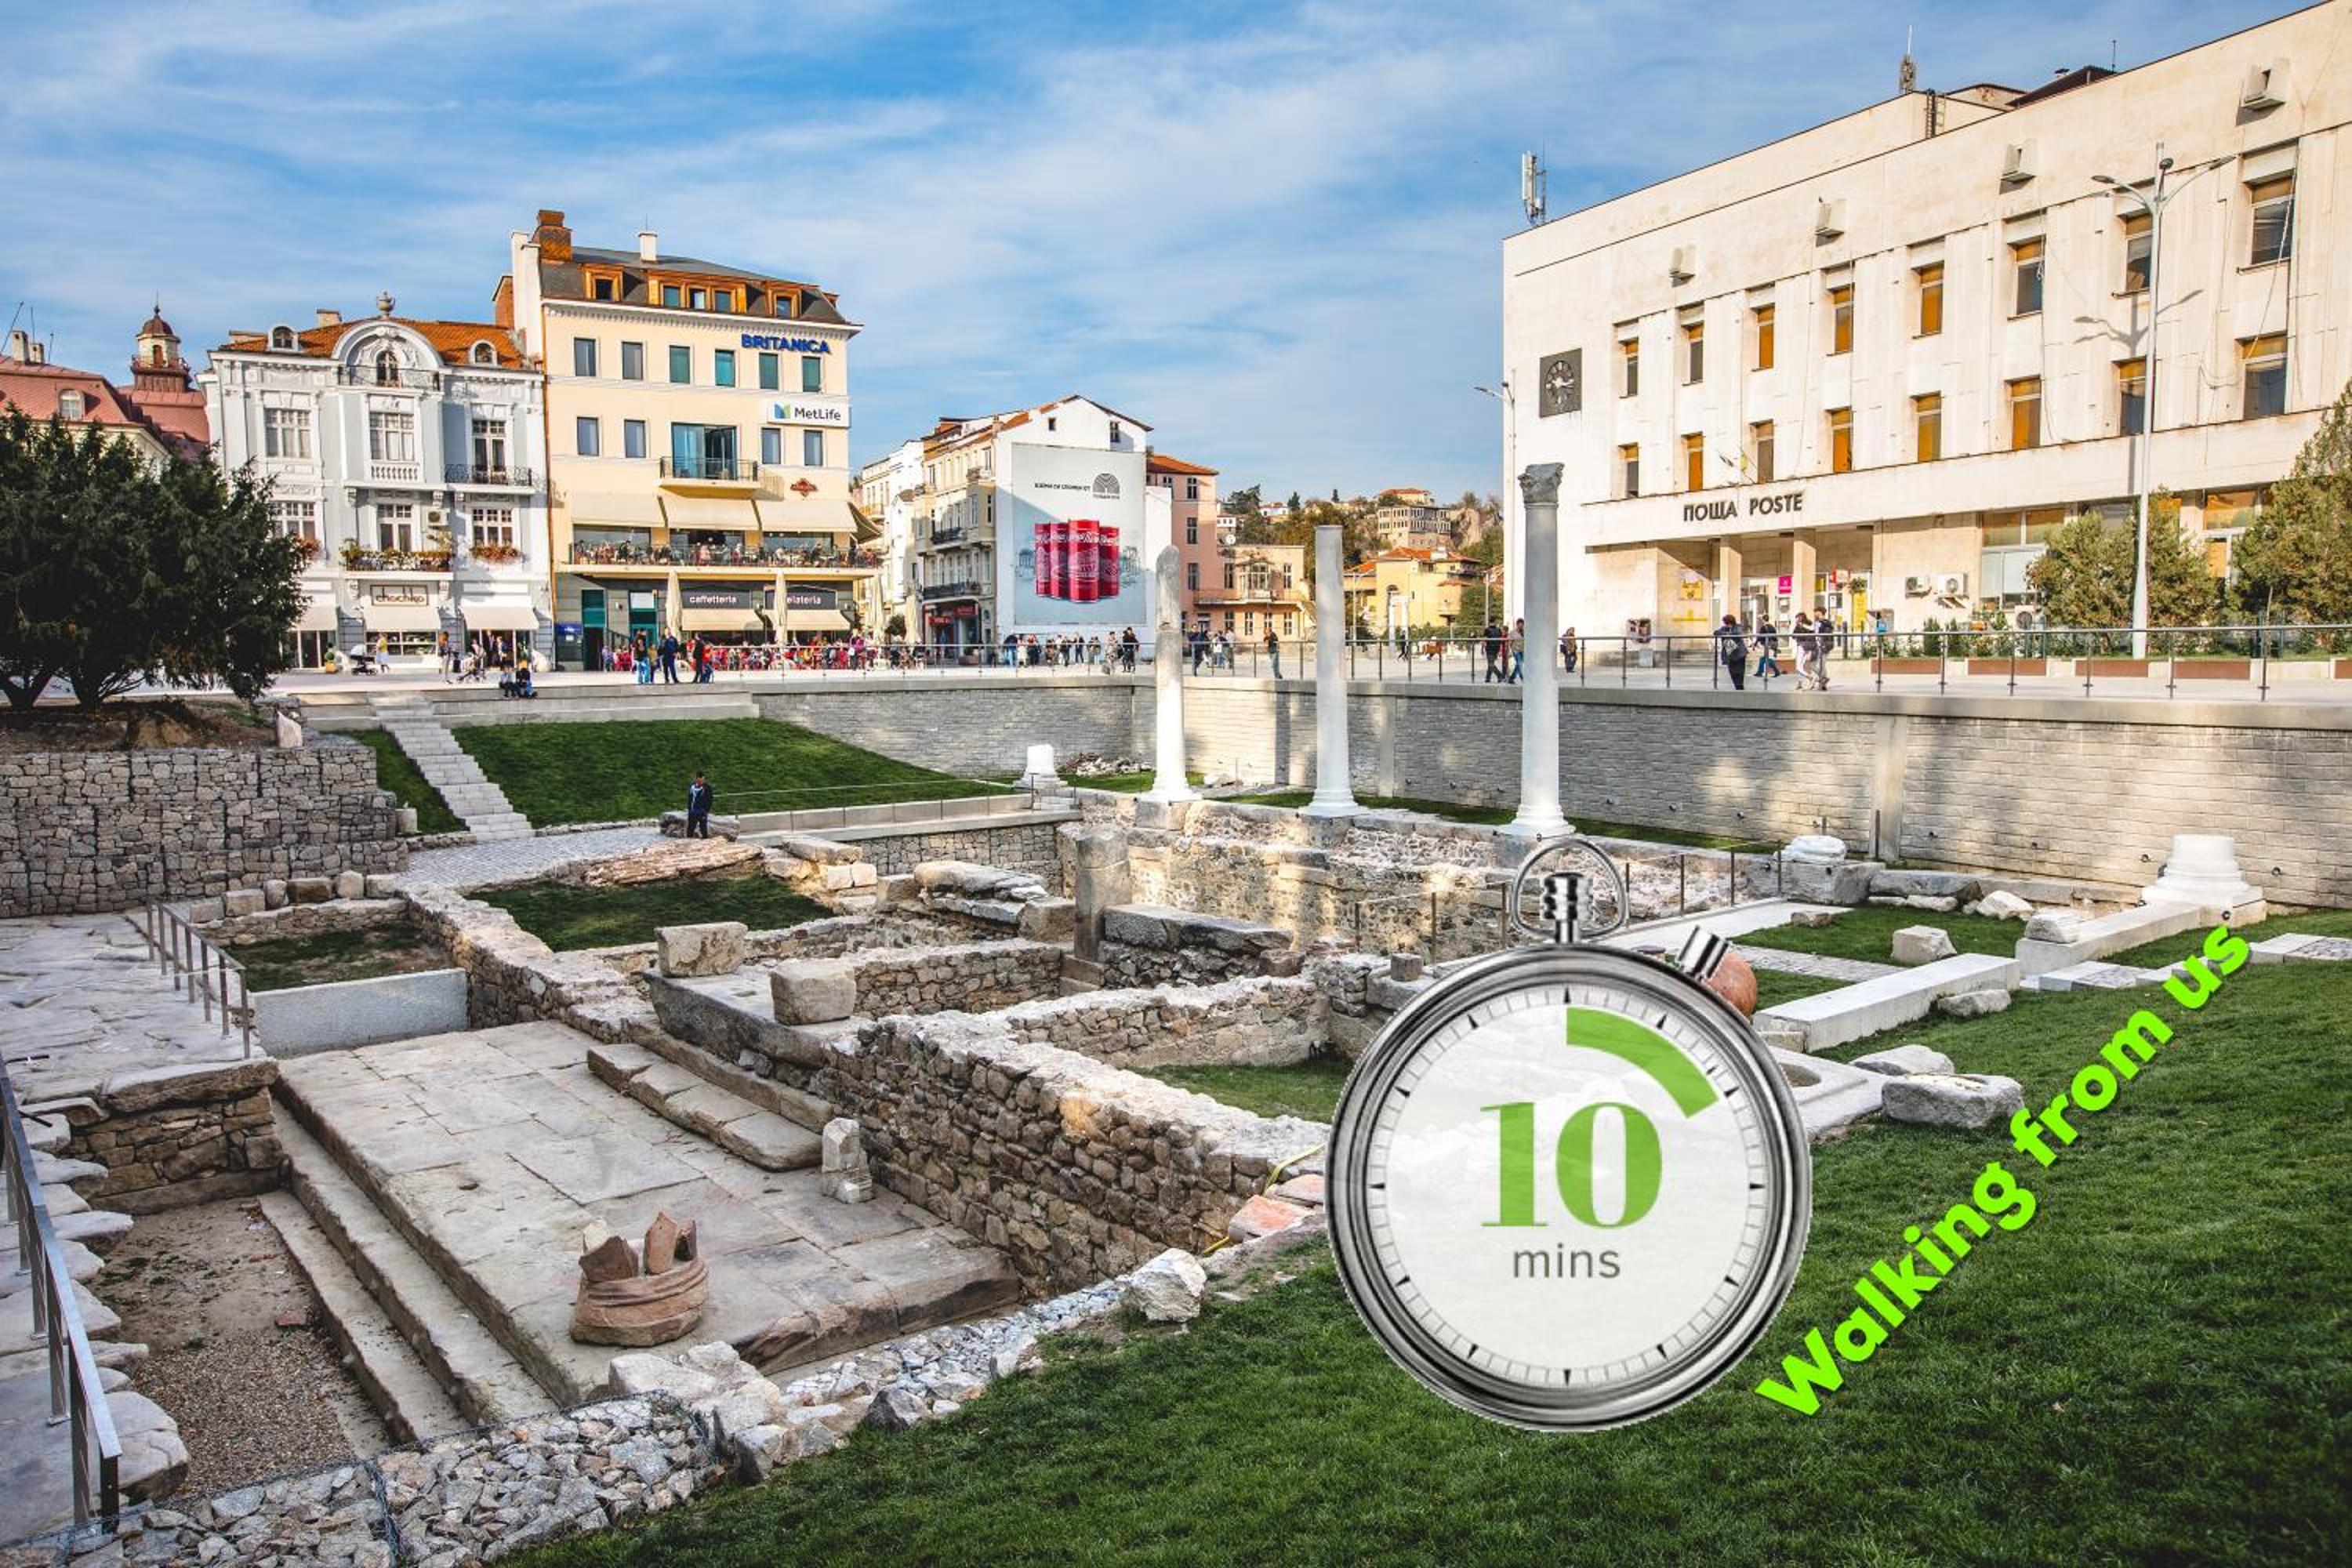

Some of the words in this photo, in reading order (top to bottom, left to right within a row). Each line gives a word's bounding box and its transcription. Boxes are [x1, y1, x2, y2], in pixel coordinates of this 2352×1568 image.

[742, 333, 831, 354] BRITANICA
[794, 407, 841, 421] MetLife
[1683, 500, 1737, 521] ПОЩА
[1749, 492, 1803, 516] POSTE
[786, 594, 822, 604] elateria
